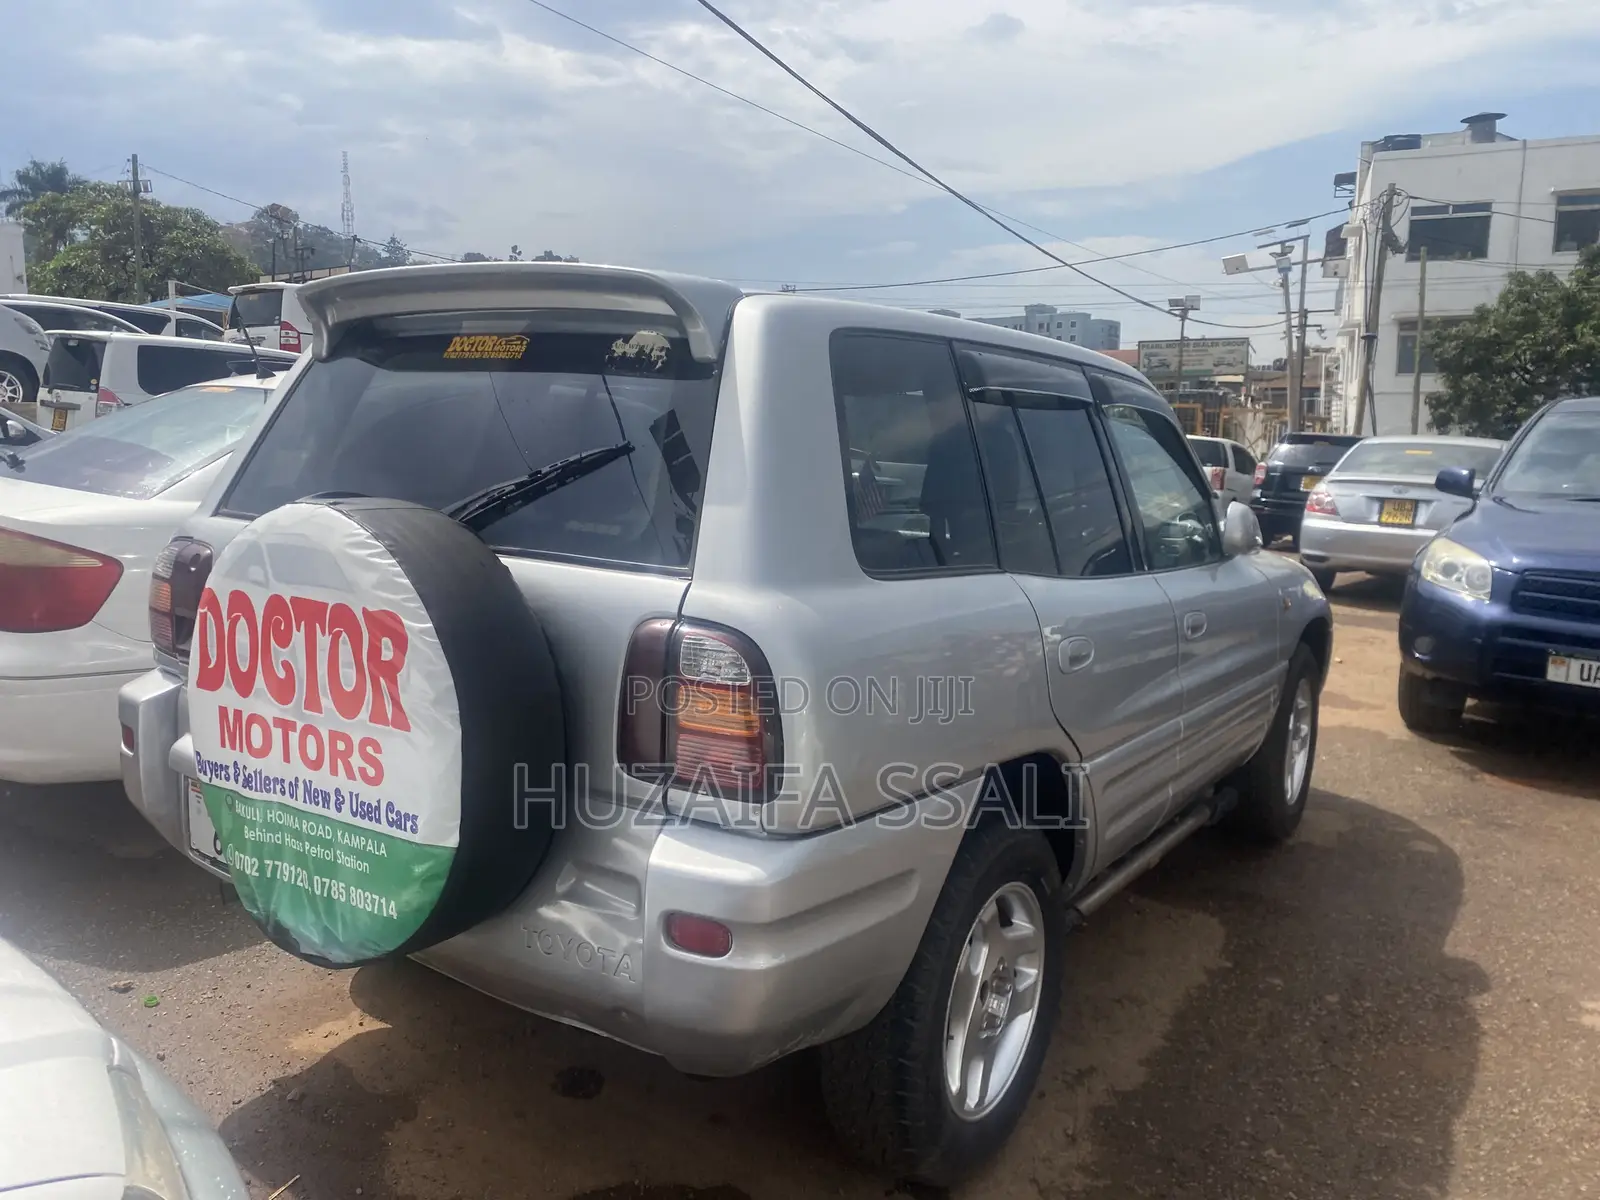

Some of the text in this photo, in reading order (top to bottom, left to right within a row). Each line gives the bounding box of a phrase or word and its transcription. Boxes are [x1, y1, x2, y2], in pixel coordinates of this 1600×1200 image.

[447, 335, 498, 352] DOCTOR
[494, 344, 527, 352] MOTORS
[196, 587, 411, 732] DOCTOR
[218, 705, 385, 787] MOTORS
[196, 751, 420, 835] Buyers & Sellers of New & Used Cars
[244, 825, 282, 845] Behind
[284, 833, 304, 853] Hass
[304, 841, 335, 862] Petrol
[336, 850, 370, 875] Station
[266, 810, 301, 830] HOIMA
[337, 829, 388, 858] KAMPALA
[234, 850, 260, 877] 0702
[313, 875, 347, 903] 0785
[350, 885, 398, 920] 803714
[520, 924, 637, 984] TOYOTA
